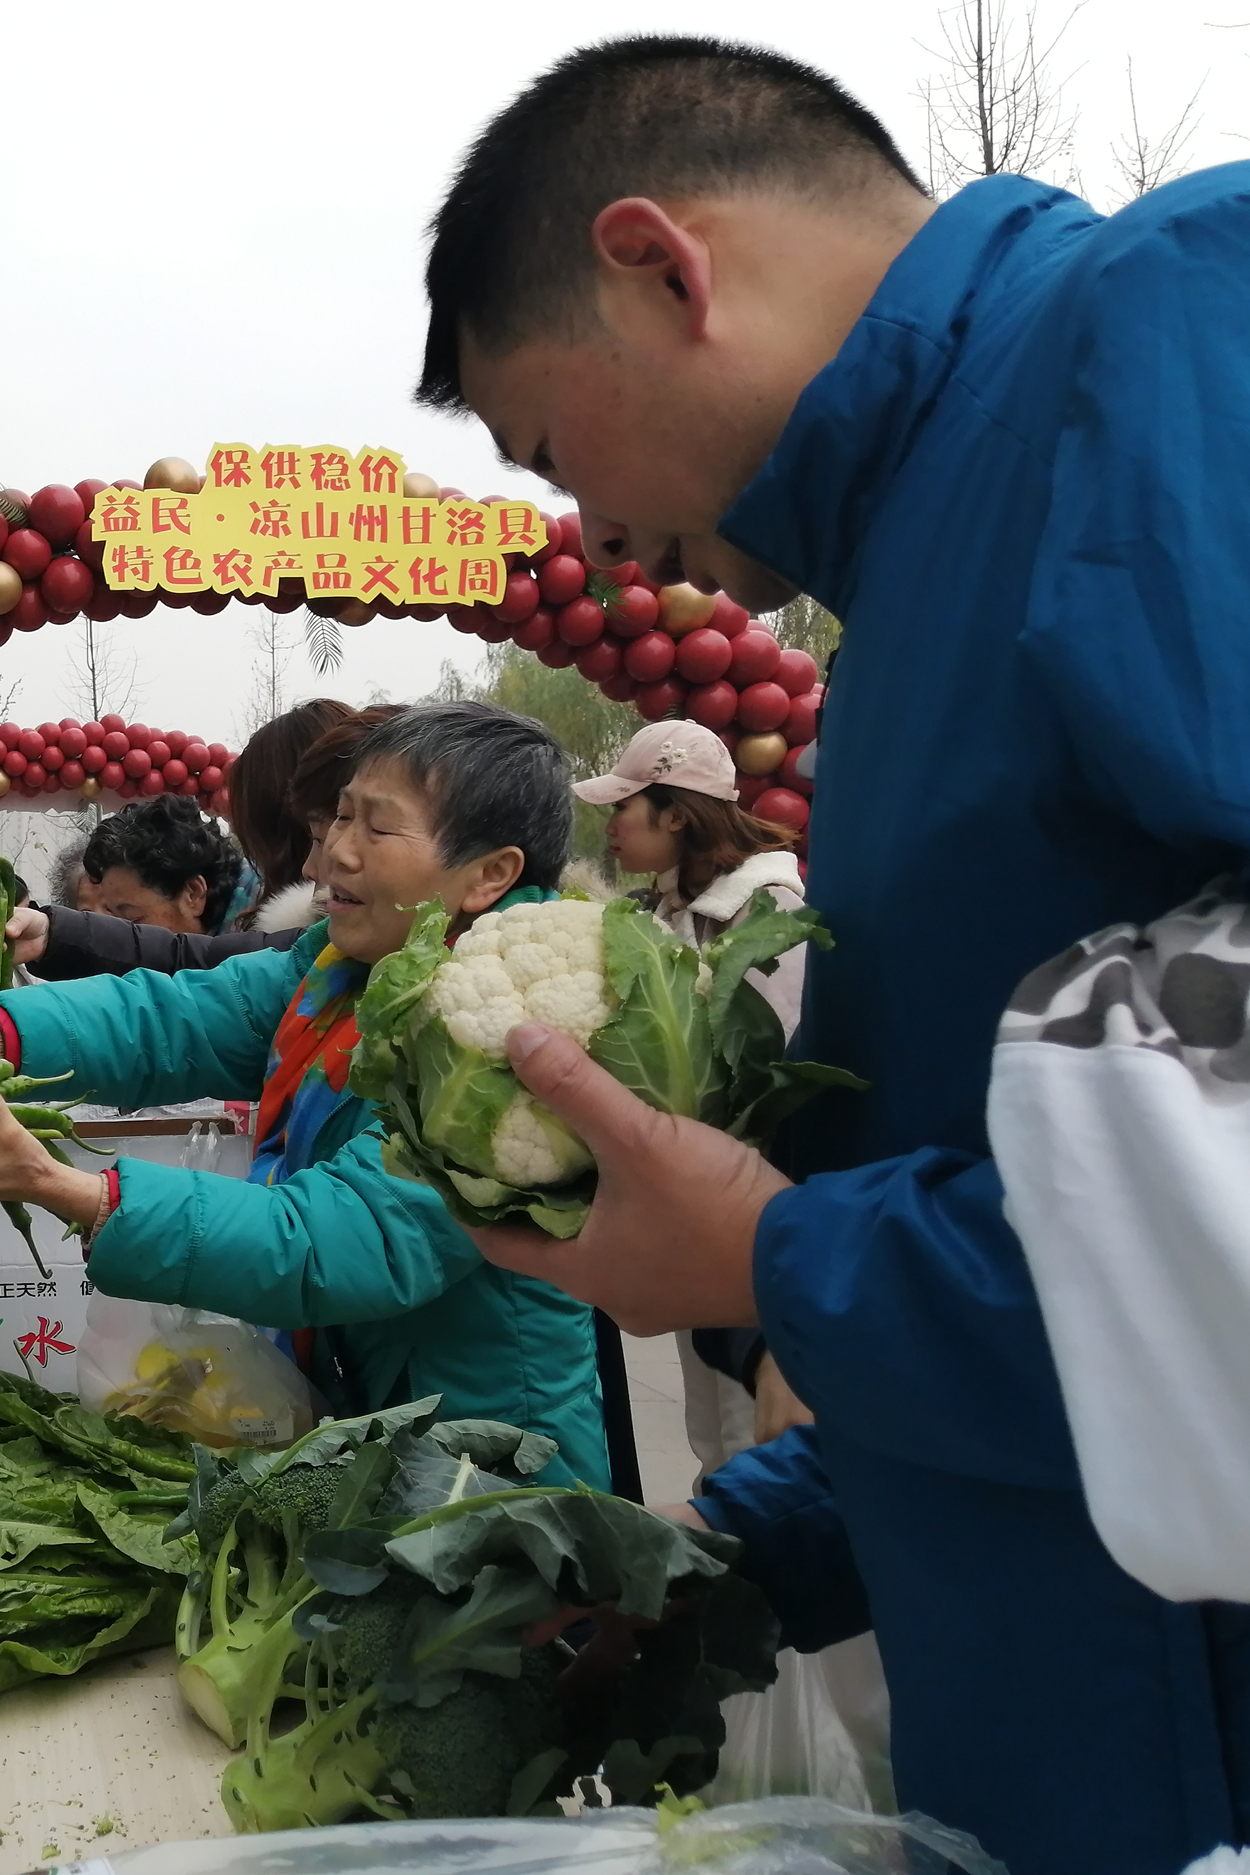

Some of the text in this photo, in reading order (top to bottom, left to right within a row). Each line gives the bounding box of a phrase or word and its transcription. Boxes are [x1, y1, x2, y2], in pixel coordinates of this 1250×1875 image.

[210, 449, 399, 493] 保供稳价
[100, 495, 537, 547] 益民·凉山州甘洛县
[112, 544, 498, 597] 特色农产品文化周
[17, 1315, 77, 1368] 水
